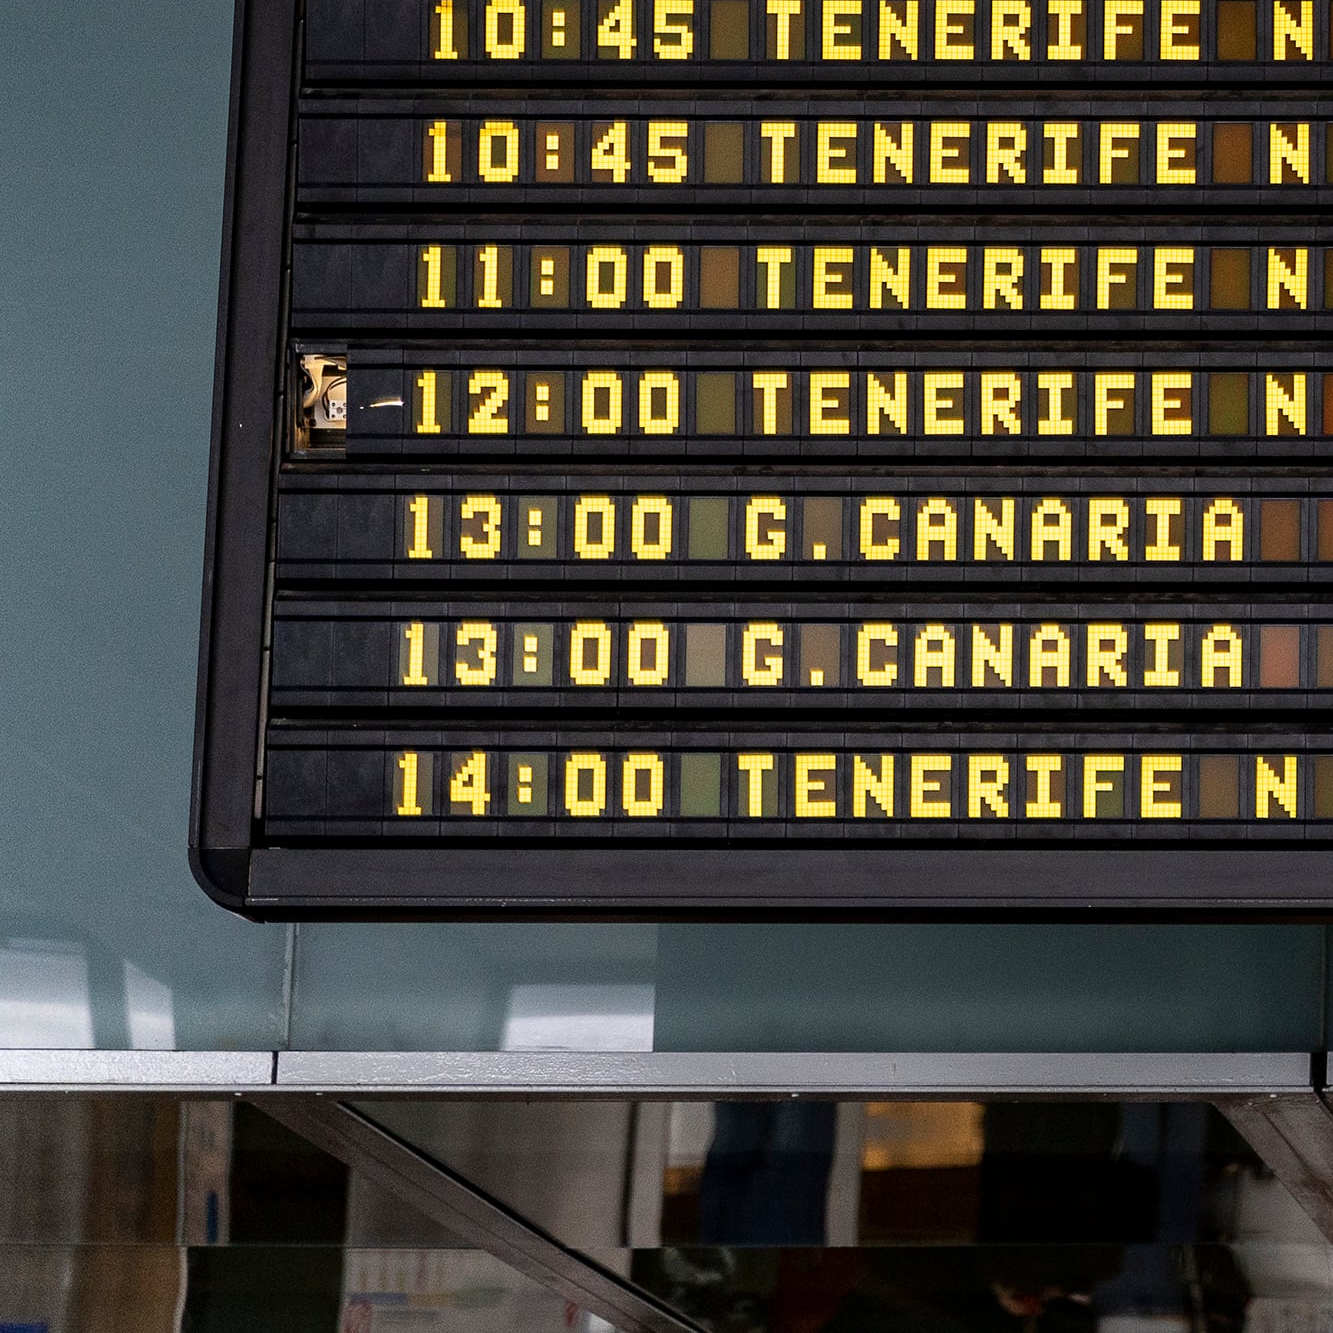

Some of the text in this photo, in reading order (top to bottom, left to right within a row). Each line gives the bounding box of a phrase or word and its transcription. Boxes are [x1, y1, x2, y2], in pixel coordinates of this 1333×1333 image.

[766, 0, 1201, 61] TENERIFE
[1273, 0, 1313, 61] N
[427, 121, 688, 183] 10:45
[760, 122, 1197, 184] TENERIFE
[1269, 123, 1310, 184] N
[421, 246, 684, 309] 11:00
[757, 247, 1195, 310] TENERIFE
[1267, 248, 1308, 310] N
[416, 368, 679, 435] 12:00
[752, 372, 1192, 436] TENERIFE
[1265, 374, 1306, 436] N
[408, 495, 673, 560] 13:00
[745, 496, 1244, 561] G.CANARIA
[402, 622, 669, 686] 13:00
[742, 623, 1243, 688] G.CANARIA
[397, 751, 664, 817] 14:00
[738, 754, 1182, 818] TENERIFE
[1255, 756, 1297, 819] N
